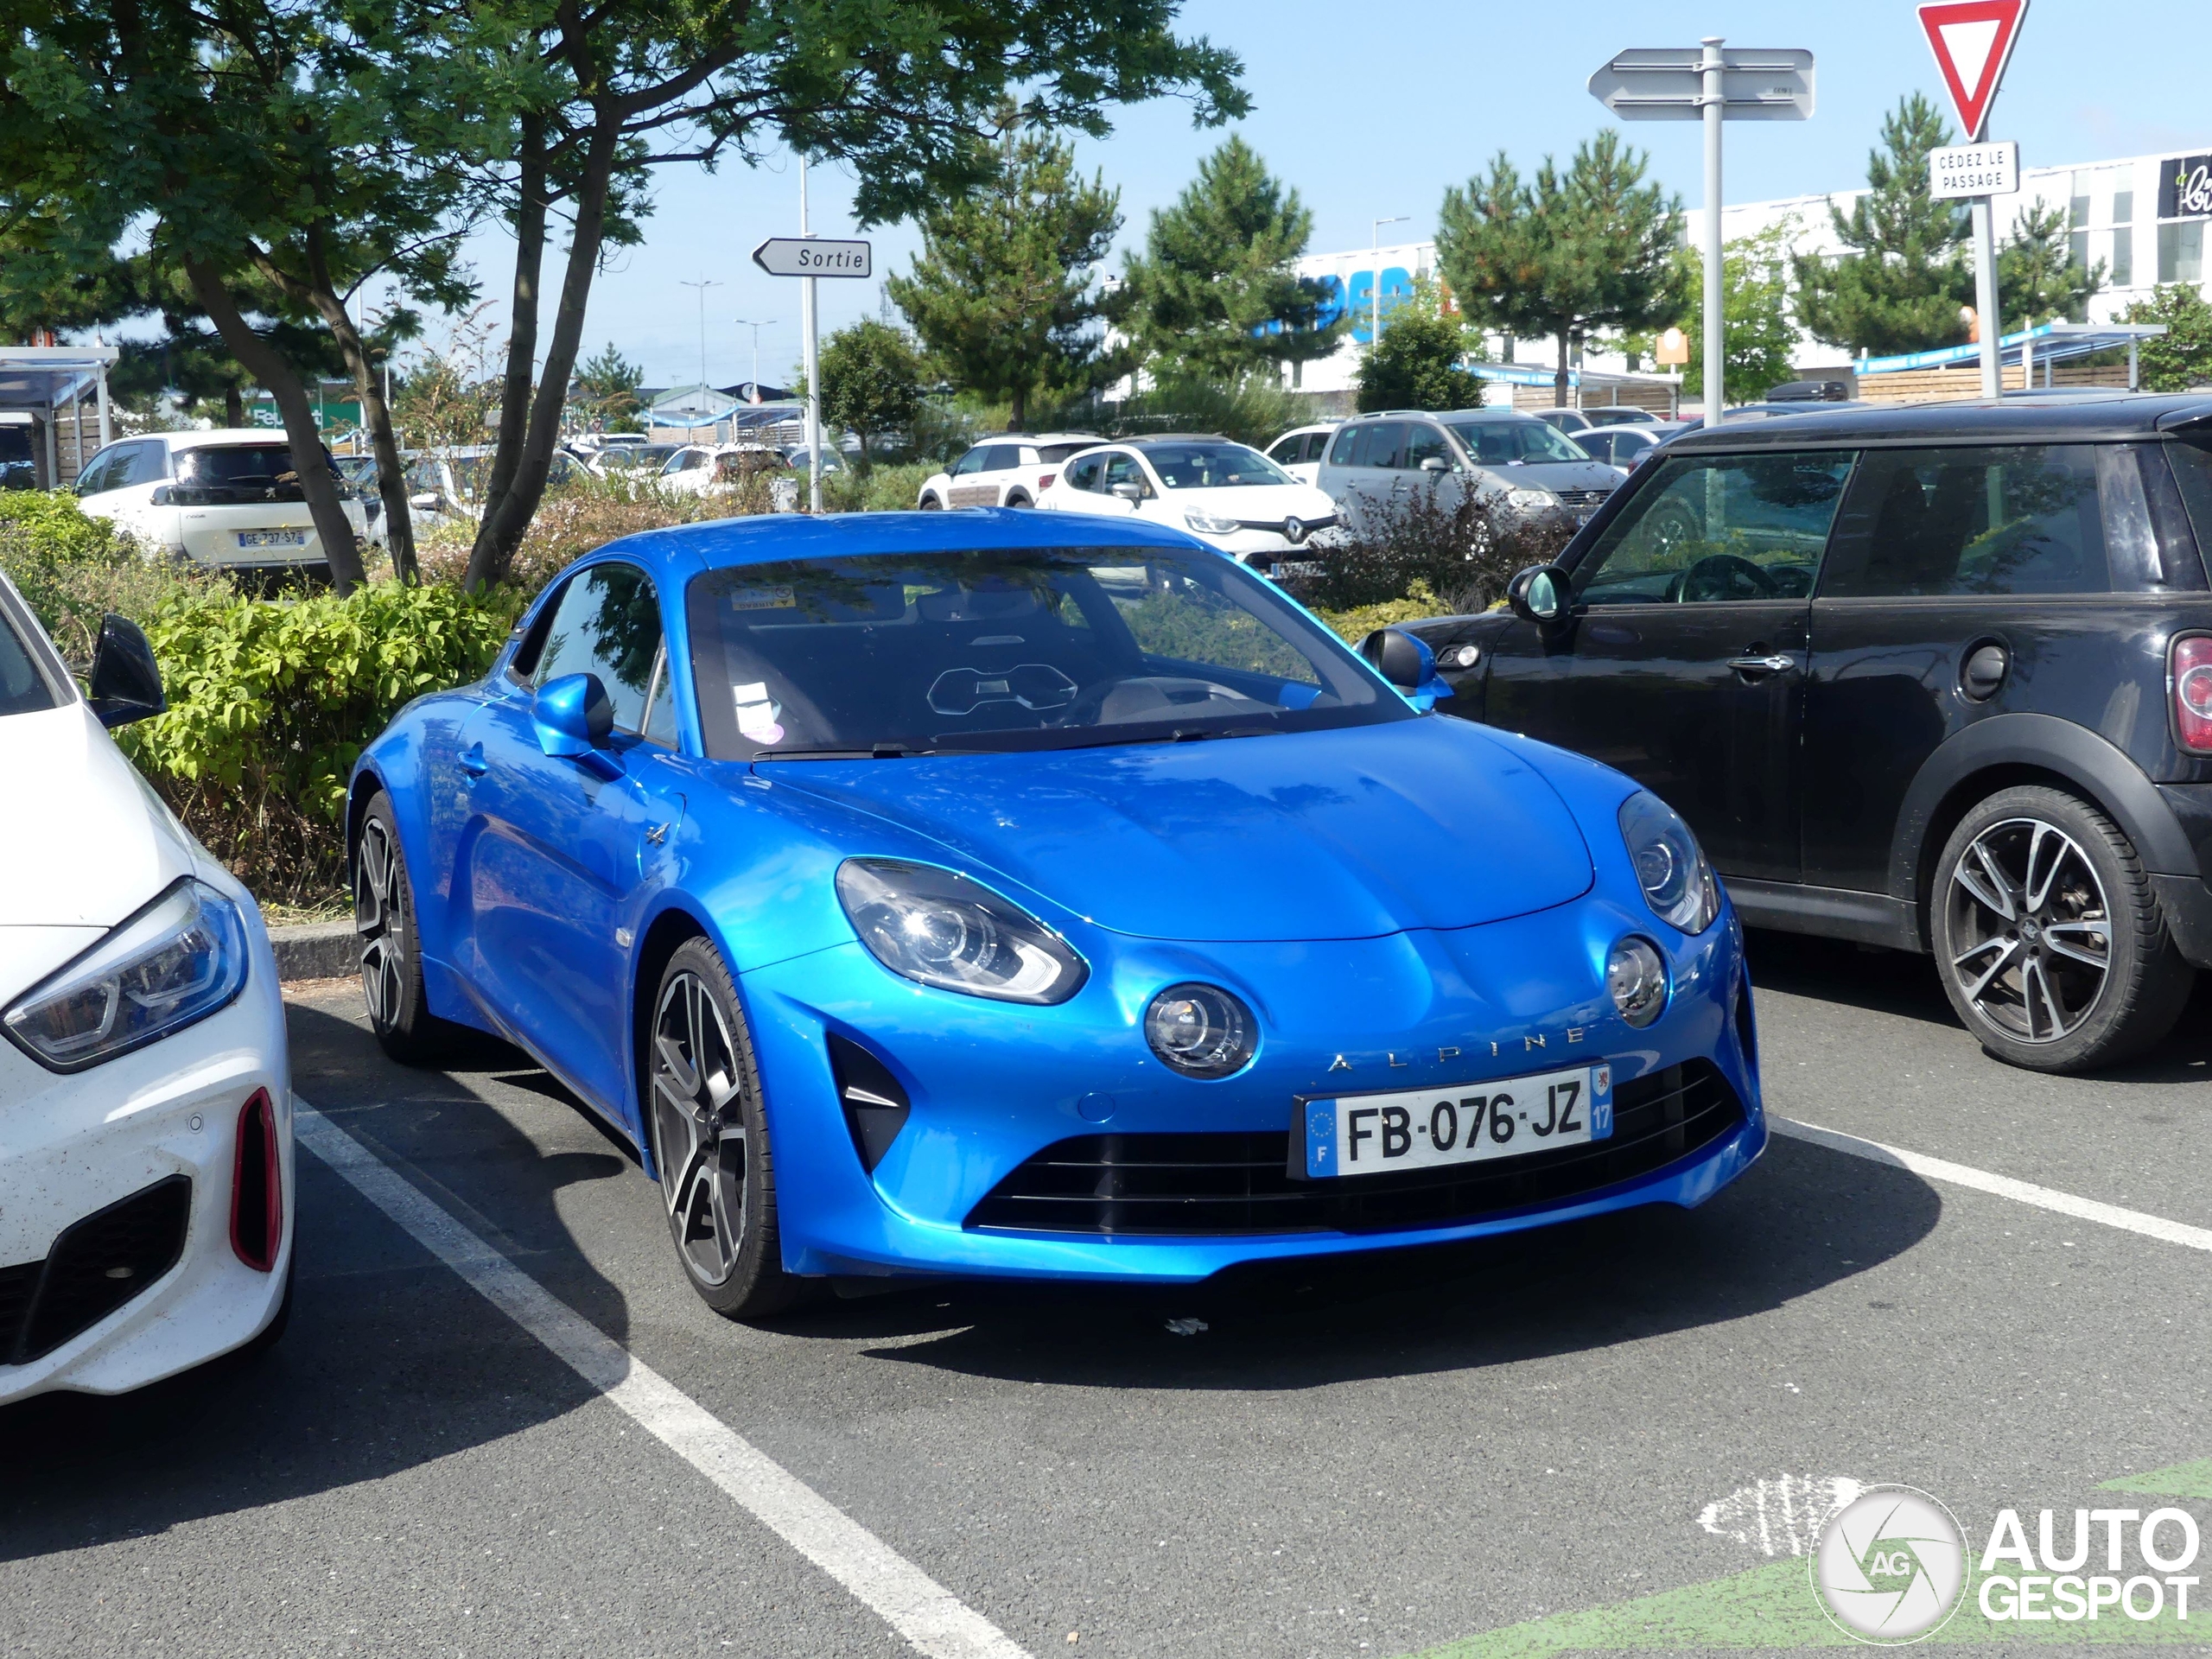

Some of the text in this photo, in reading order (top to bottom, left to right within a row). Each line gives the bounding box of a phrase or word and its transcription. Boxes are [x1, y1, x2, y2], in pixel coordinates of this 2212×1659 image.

[1940, 150, 2004, 169] CÉDEZ LE
[1943, 172, 2002, 189] PASSAGE
[798, 249, 863, 268] Sortie
[1328, 1027, 1583, 1072] ALPINE
[1348, 1081, 1581, 1161] FB-076-JZ
[1592, 1103, 1611, 1129] 17
[1318, 1146, 1327, 1162] F
